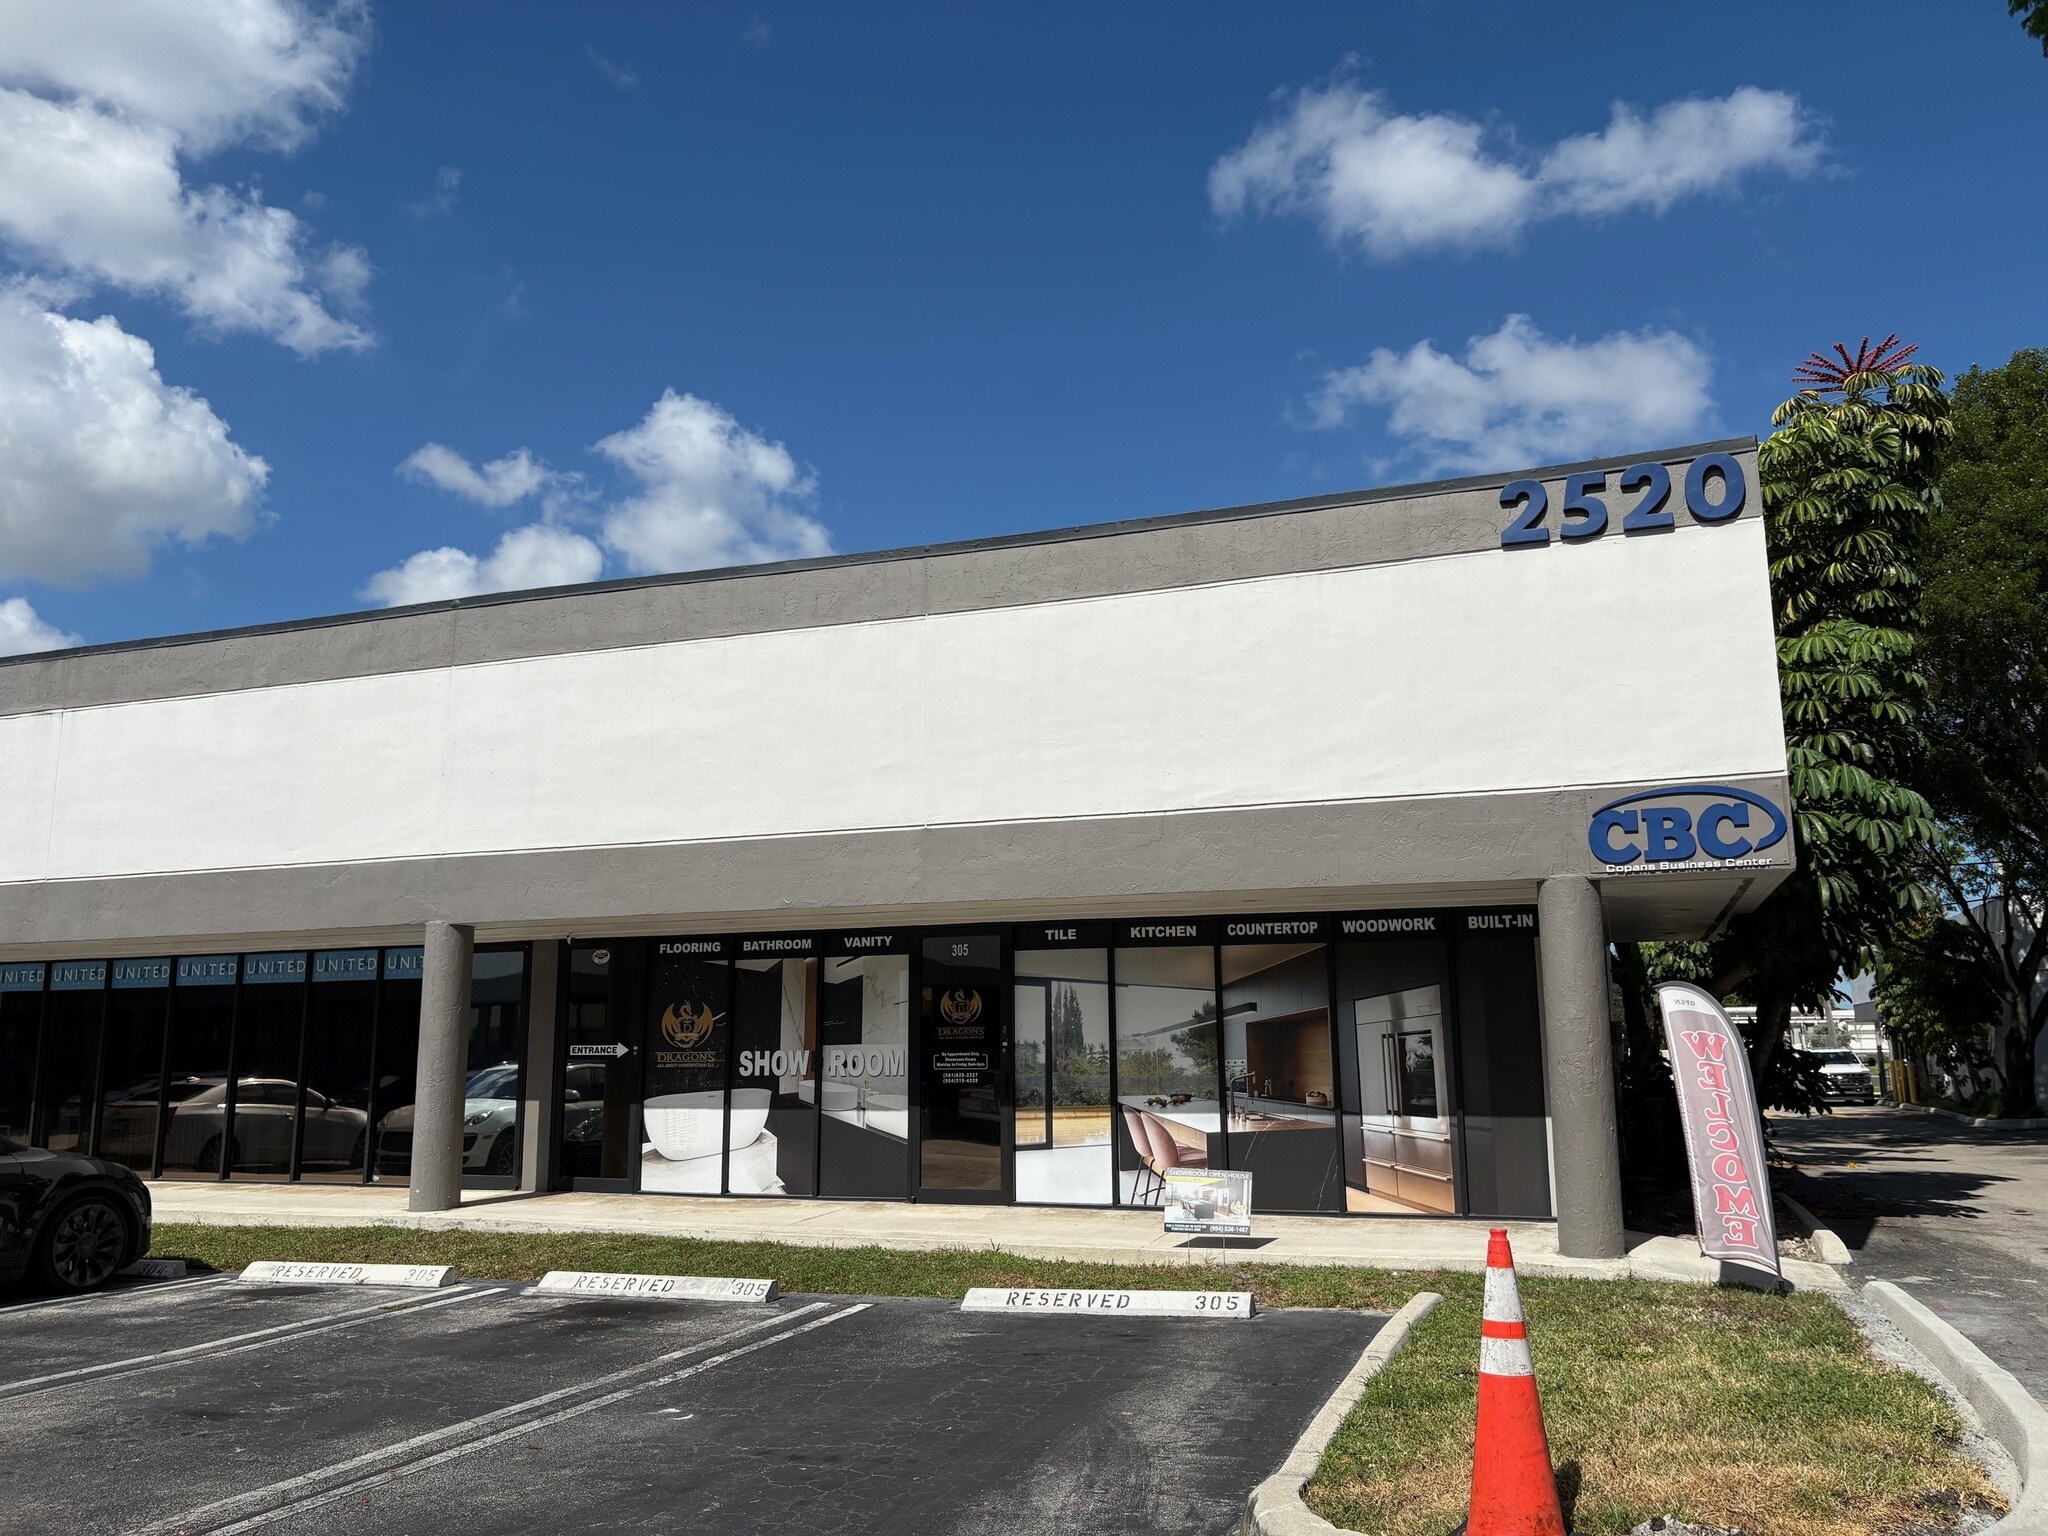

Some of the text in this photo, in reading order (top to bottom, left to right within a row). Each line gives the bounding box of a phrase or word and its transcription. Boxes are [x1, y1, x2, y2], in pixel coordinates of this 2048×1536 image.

[1500, 452, 1746, 548] 2520
[1589, 802, 1757, 865] CBC
[1605, 857, 1773, 874] Copans Business Center
[1342, 917, 1436, 934] WOODWORK
[1468, 914, 1533, 928] BUILT-IN
[1045, 929, 1077, 941] TILE
[1130, 926, 1197, 938] KITCHEN
[1227, 922, 1318, 936] COUNTERTOP
[659, 942, 721, 954] FLOORING
[743, 938, 812, 951] BATHROOM
[843, 935, 893, 948] VANITY
[951, 943, 969, 957] 305
[247, 960, 306, 974] UNITED
[316, 958, 377, 972] UNITED
[388, 956, 425, 969] UNIT
[54, 968, 106, 982] UNITED
[115, 966, 170, 980] UNITED
[180, 963, 237, 977] UNITED
[572, 1046, 618, 1054] ENTRANCE
[738, 1048, 905, 1078] SHOW ROOM
[1169, 1169, 1208, 1177] SHOWROOM
[137, 1263, 167, 1276] 304
[274, 1264, 438, 1281] RESERVED 305
[574, 1275, 768, 1296] RESERVED 305
[1006, 1291, 1241, 1311] RESERVED 305
